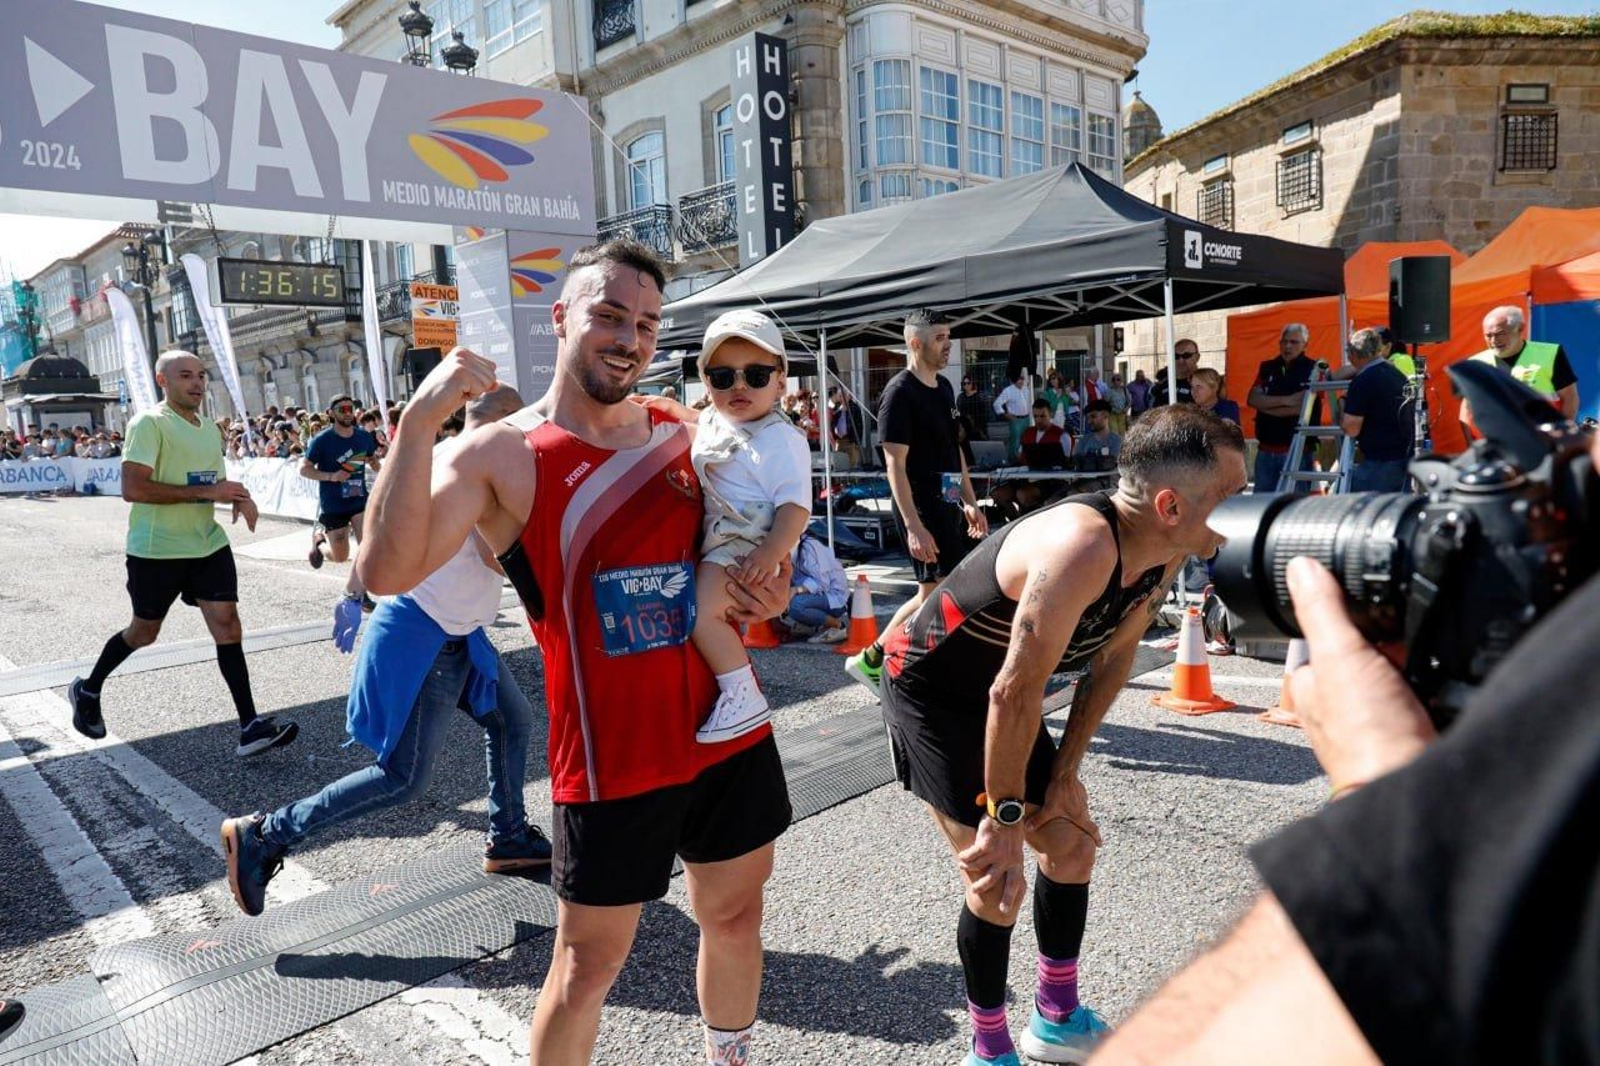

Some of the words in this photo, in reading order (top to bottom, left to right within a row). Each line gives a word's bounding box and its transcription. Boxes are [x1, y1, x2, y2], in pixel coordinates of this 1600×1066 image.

[104, 23, 388, 203] BAY
[20, 139, 82, 171] 2024
[735, 46, 758, 259] HOTEL
[382, 180, 430, 206] MEDIO
[434, 185, 501, 213] MARATÓN
[505, 193, 541, 218] GRAN
[543, 195, 581, 221] BAHÍA
[1204, 242, 1242, 260] CCNORTE
[240, 270, 337, 298] 1:36:15
